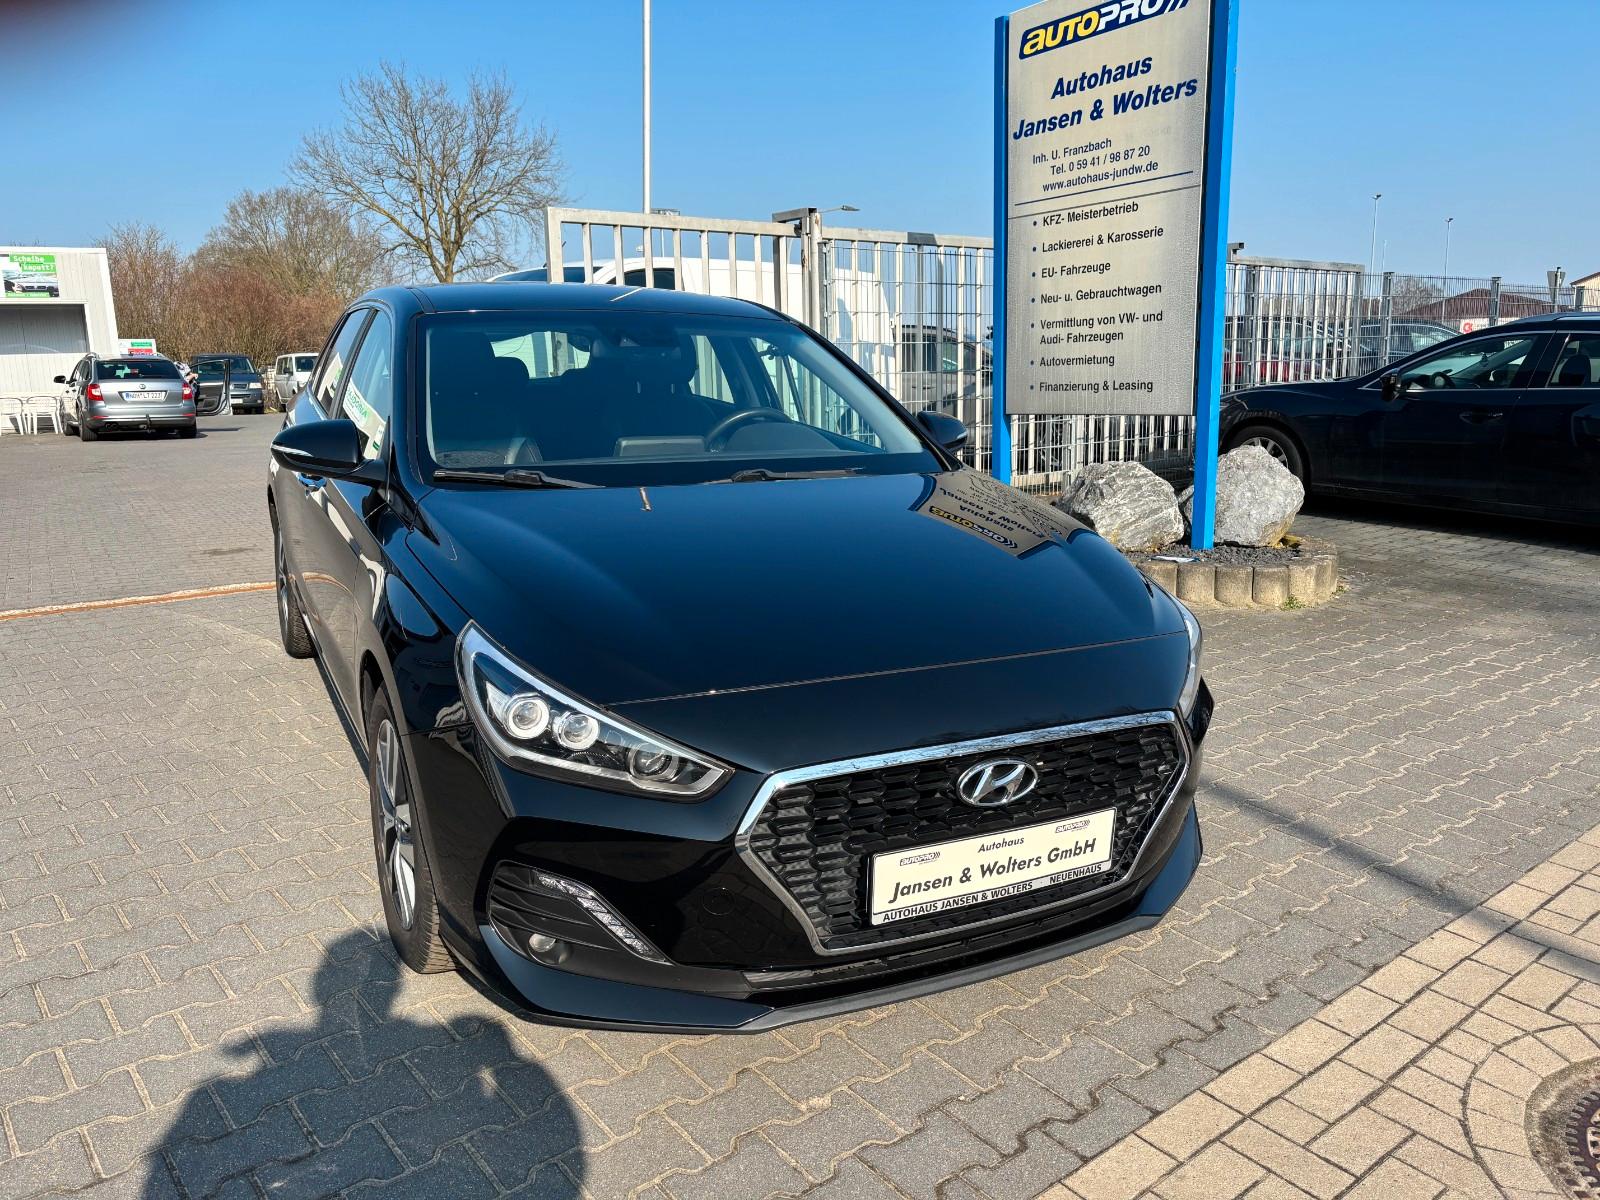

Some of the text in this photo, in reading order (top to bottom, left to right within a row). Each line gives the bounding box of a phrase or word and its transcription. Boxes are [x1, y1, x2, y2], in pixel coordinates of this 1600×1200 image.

[1051, 56, 1152, 99] Autohaus
[1013, 78, 1198, 140] Jansen & Wolters
[1033, 138, 1112, 164] Inh. U. Franzbach
[1050, 145, 1150, 176] Tel. 0 59 41 / 98 87 20
[1042, 160, 1159, 192] www.autohaus-jundw.de
[1042, 201, 1139, 227] KFZ- Meisterbetrieb
[1042, 226, 1164, 253] Lackiererei & Karosserie
[1041, 261, 1111, 278] EU- Fahrzeuge
[1040, 283, 1162, 304] Neu- u. Gebrauchtwagen
[1040, 310, 1163, 330] Vermittlung von VW- und
[1040, 330, 1124, 346] Audi- Fahrzeugen
[1039, 354, 1115, 368] Autovermietung
[1039, 379, 1154, 393] Finanzierung & Leasing
[978, 836, 1024, 853] Autohaus
[888, 838, 1096, 904] Jansen & Wolters GmbH
[883, 863, 1102, 922] AUTOHAUS JANSEN & WOLTERS NEUENHAUS
